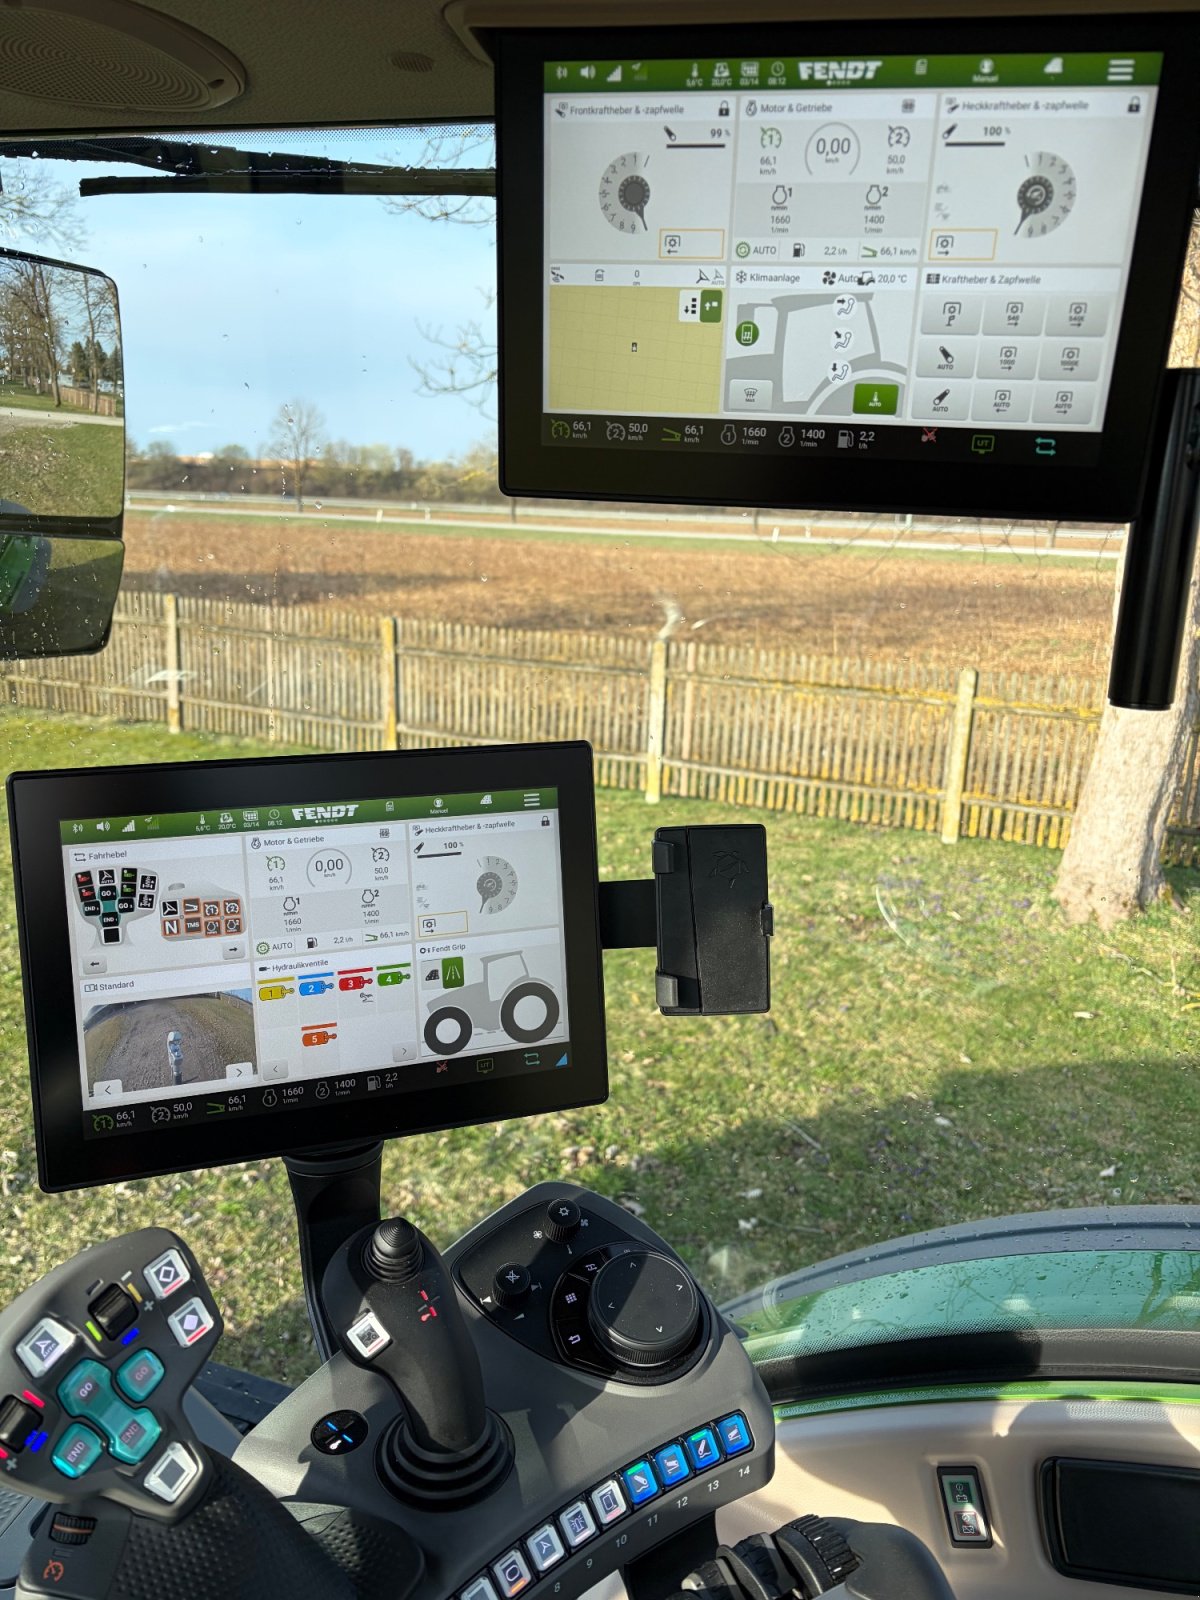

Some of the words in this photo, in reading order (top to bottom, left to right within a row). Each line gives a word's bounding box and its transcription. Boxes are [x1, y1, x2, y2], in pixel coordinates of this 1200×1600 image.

[798, 60, 883, 80] FENDT
[570, 106, 632, 115] Frontkraftheber
[634, 106, 640, 114] &
[760, 104, 784, 112] Motor
[788, 104, 794, 112] &
[796, 103, 832, 112] Getriebe
[962, 101, 1032, 111] Heckkraftheber
[1033, 101, 1040, 110] &
[710, 128, 722, 138] 99
[984, 126, 1002, 136] 100
[816, 138, 851, 156] 0,00
[760, 156, 776, 166] 66,1
[887, 154, 906, 165] 50,0
[770, 215, 791, 224] 1660
[864, 215, 885, 224] 1400
[771, 226, 789, 234] 1/min
[864, 226, 883, 234] 1/min
[752, 246, 776, 255] AUTO
[824, 246, 836, 256] 2,2
[880, 246, 898, 256] 66,1
[899, 247, 917, 256] km/h
[750, 274, 800, 284] Klimaanlage
[838, 274, 858, 283] Auto
[878, 274, 896, 284] 20,0
[897, 274, 908, 283] °C
[942, 275, 988, 284] Kraftheber
[990, 275, 996, 284] &
[998, 275, 1042, 286] Zapfwelle
[572, 421, 591, 432] 66,1
[628, 423, 648, 434] 50,0
[684, 425, 704, 436] 66,1
[742, 427, 767, 437] 1660
[801, 429, 825, 439] 1400
[859, 431, 875, 442] 2,2
[742, 438, 759, 446] 1/min
[800, 440, 818, 448] 1/min
[291, 804, 360, 821] FENDT
[425, 824, 475, 836] Heckkraftheber
[482, 820, 516, 830] -zapfwelle
[263, 838, 285, 847] Motor
[287, 837, 293, 846] &
[293, 834, 325, 844] Getriebe
[443, 842, 458, 850] 100
[88, 850, 127, 860] Fahrhebel
[315, 858, 344, 874] 0,00
[374, 867, 389, 875] 50,0
[268, 876, 283, 884] 66,1
[269, 884, 284, 892] km/h
[118, 902, 128, 910] GO
[362, 910, 380, 918] 1400
[284, 918, 302, 926] 1660
[164, 922, 178, 935] N
[379, 931, 394, 940] 66,1
[333, 937, 344, 946] 2,2
[272, 942, 293, 952] AUTO
[431, 945, 450, 953] Fendt
[452, 943, 466, 952] Grip
[272, 960, 329, 973] Hydraulikventile
[99, 980, 135, 992] Standard
[385, 1072, 398, 1083] 2,2
[334, 1078, 356, 1090] 1400
[282, 1086, 304, 1098] 1660
[335, 1089, 350, 1097] 1/min
[228, 1094, 246, 1105] 66,1
[173, 1102, 192, 1113] 50,0
[228, 1104, 244, 1112] km/h
[116, 1110, 135, 1122] 66,1
[135, 1366, 149, 1381] GO
[79, 1382, 93, 1398] GO
[121, 1422, 139, 1443] END
[67, 1440, 85, 1463] END
[738, 1464, 751, 1478] 14
[707, 1480, 720, 1493] 13
[676, 1496, 688, 1509] 12
[647, 1513, 659, 1527] 11
[615, 1534, 628, 1548] 10
[586, 1558, 593, 1570] 9
[554, 1582, 561, 1593] 8
